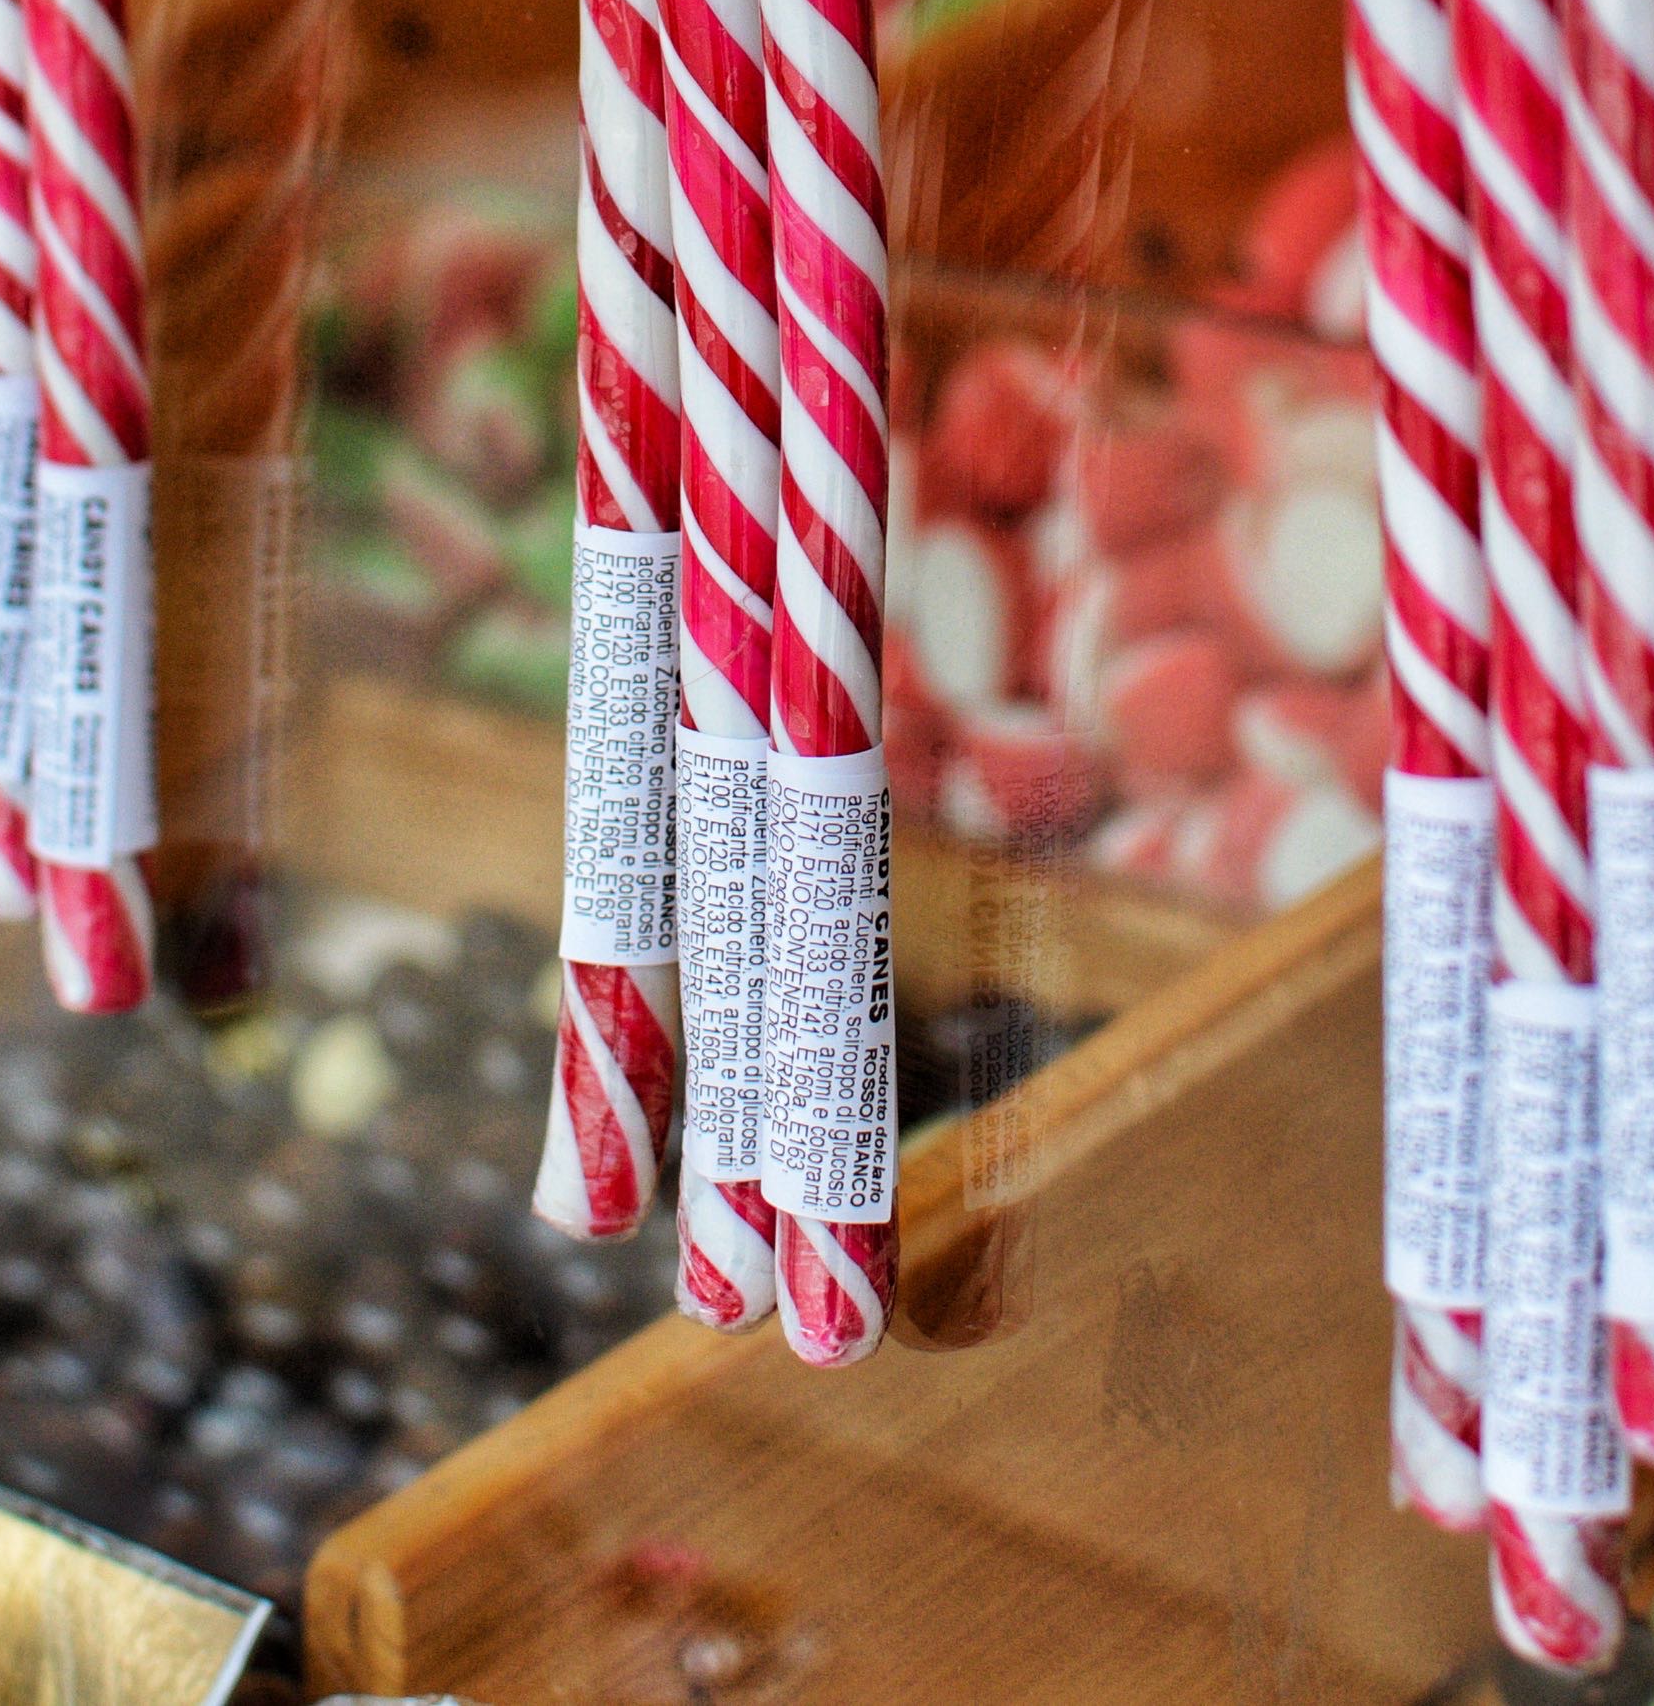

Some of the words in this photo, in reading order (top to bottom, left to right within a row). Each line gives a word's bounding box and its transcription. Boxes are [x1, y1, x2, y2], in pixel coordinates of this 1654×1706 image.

[612, 555, 636, 608] E100,
[656, 554, 678, 658] Ingredienti:
[634, 557, 655, 665] acidificante:
[573, 616, 591, 695] Prodotto
[609, 617, 633, 669] E120,
[574, 705, 584, 719] in
[607, 679, 630, 730] E133,
[631, 674, 649, 723] acido
[647, 665, 673, 759] Zucchero,
[602, 739, 626, 791] E141,
[623, 731, 647, 789] citrico,
[707, 758, 731, 812] E100,
[599, 800, 622, 865] E160a,
[623, 798, 640, 849] aromi
[642, 766, 665, 845] sciroppo
[730, 760, 751, 874] acidificante:
[768, 779, 782, 863] CIDNEO
[816, 796, 846, 850] E100,
[576, 805, 599, 890] TRACCE
[621, 856, 635, 866] e
[643, 852, 660, 868] di
[680, 819, 691, 900] Prodotto
[707, 821, 729, 875] E120,
[836, 796, 862, 911] acidificante:
[859, 793, 880, 904] Ingredienti:
[877, 788, 889, 899] CANDY
[574, 896, 593, 917] DI
[592, 873, 616, 926] E163,
[706, 885, 726, 937] E133,
[728, 882, 747, 933] acido
[772, 857, 792, 938] Prodotto
[809, 860, 838, 914] E120,
[633, 874, 658, 957] glucosio,
[681, 907, 690, 924] in
[704, 947, 723, 1001] E141,
[721, 941, 745, 999] citrico,
[771, 944, 784, 960] in
[805, 924, 831, 976] E133,
[830, 920, 851, 972] acido
[844, 912, 873, 1009] Zucchero,
[870, 912, 889, 1023] CANES
[770, 966, 782, 997] EU
[780, 909, 808, 1045] CONTENERE
[722, 1009, 737, 1061] aromi
[740, 978, 762, 1059] sciroppo
[795, 986, 823, 1038] E141,
[816, 979, 847, 1038] citrico,
[697, 1010, 721, 1074] E160a,
[763, 1005, 779, 1119] DOLCIARIA
[835, 1017, 863, 1099] sciroppo
[721, 1069, 736, 1080] e
[744, 1066, 762, 1083] di
[771, 1051, 794, 1135] TRACCE
[789, 1048, 816, 1111] E160a,
[814, 1048, 836, 1100] aromi
[859, 1048, 876, 1123] ROSSO/
[876, 1044, 889, 1121] Prodotto
[697, 1084, 719, 1137] E163,
[736, 1089, 761, 1171] glucosio,
[813, 1108, 829, 1118] e
[835, 1106, 855, 1123] di
[770, 1140, 785, 1165] DI
[782, 1121, 808, 1173] E163,
[821, 1130, 852, 1213] glucosio,
[851, 1132, 872, 1207] BIANCO
[870, 1127, 887, 1203] dolciario
